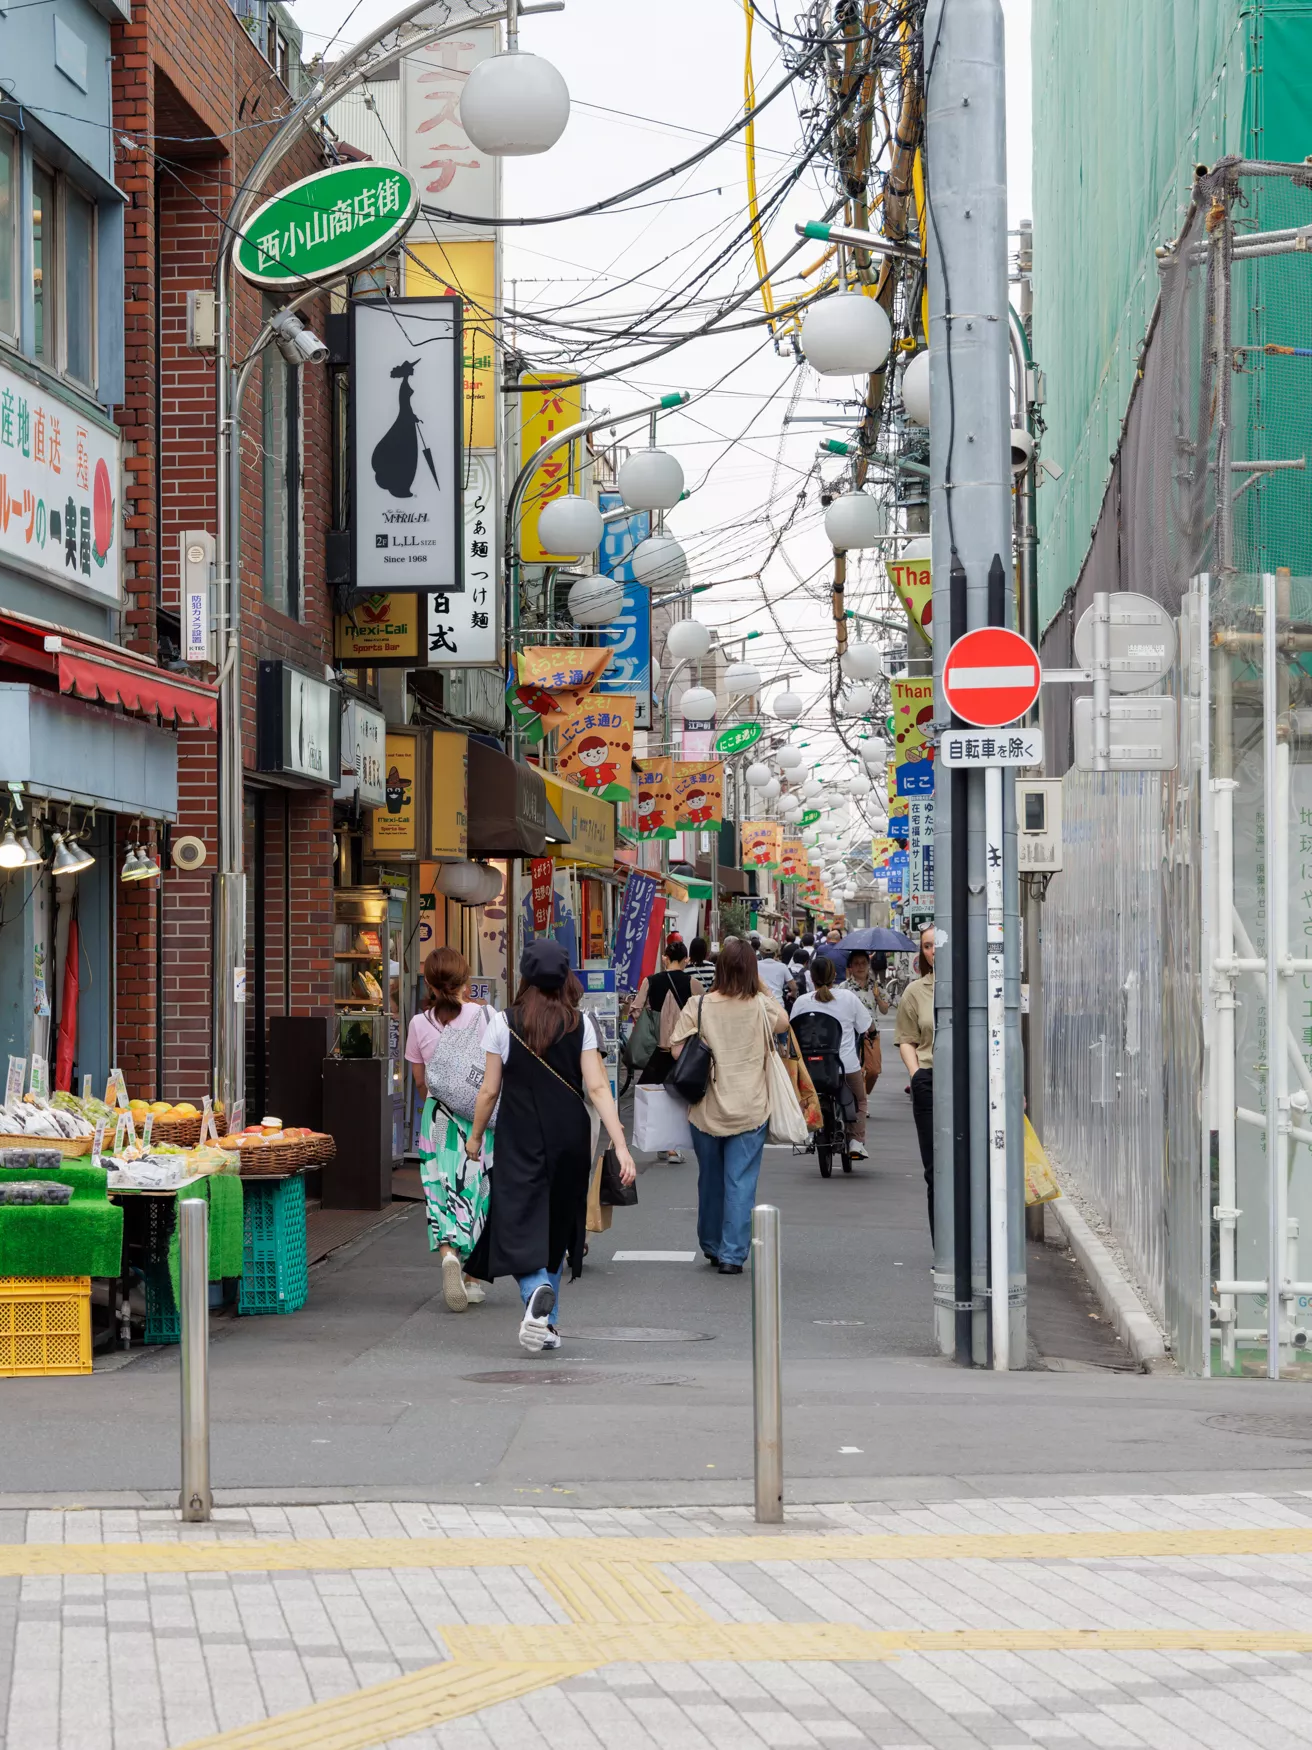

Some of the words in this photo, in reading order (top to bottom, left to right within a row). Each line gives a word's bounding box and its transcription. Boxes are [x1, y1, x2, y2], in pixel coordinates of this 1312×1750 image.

[257, 176, 401, 271] 西小山商店街
[1, 386, 61, 474] 産地直送
[408, 555, 428, 563] 1968
[471, 571, 488, 628] つけ麺
[191, 595, 202, 644] 防犯カメラ設置
[353, 644, 383, 653] Sports
[895, 684, 931, 698] Than
[719, 726, 757, 751] にこま通り
[950, 738, 1034, 760] 自転車を除く
[924, 803, 934, 836] ゆたか
[911, 803, 920, 893] 在宅福祉サービス
[470, 984, 489, 997] 3F
